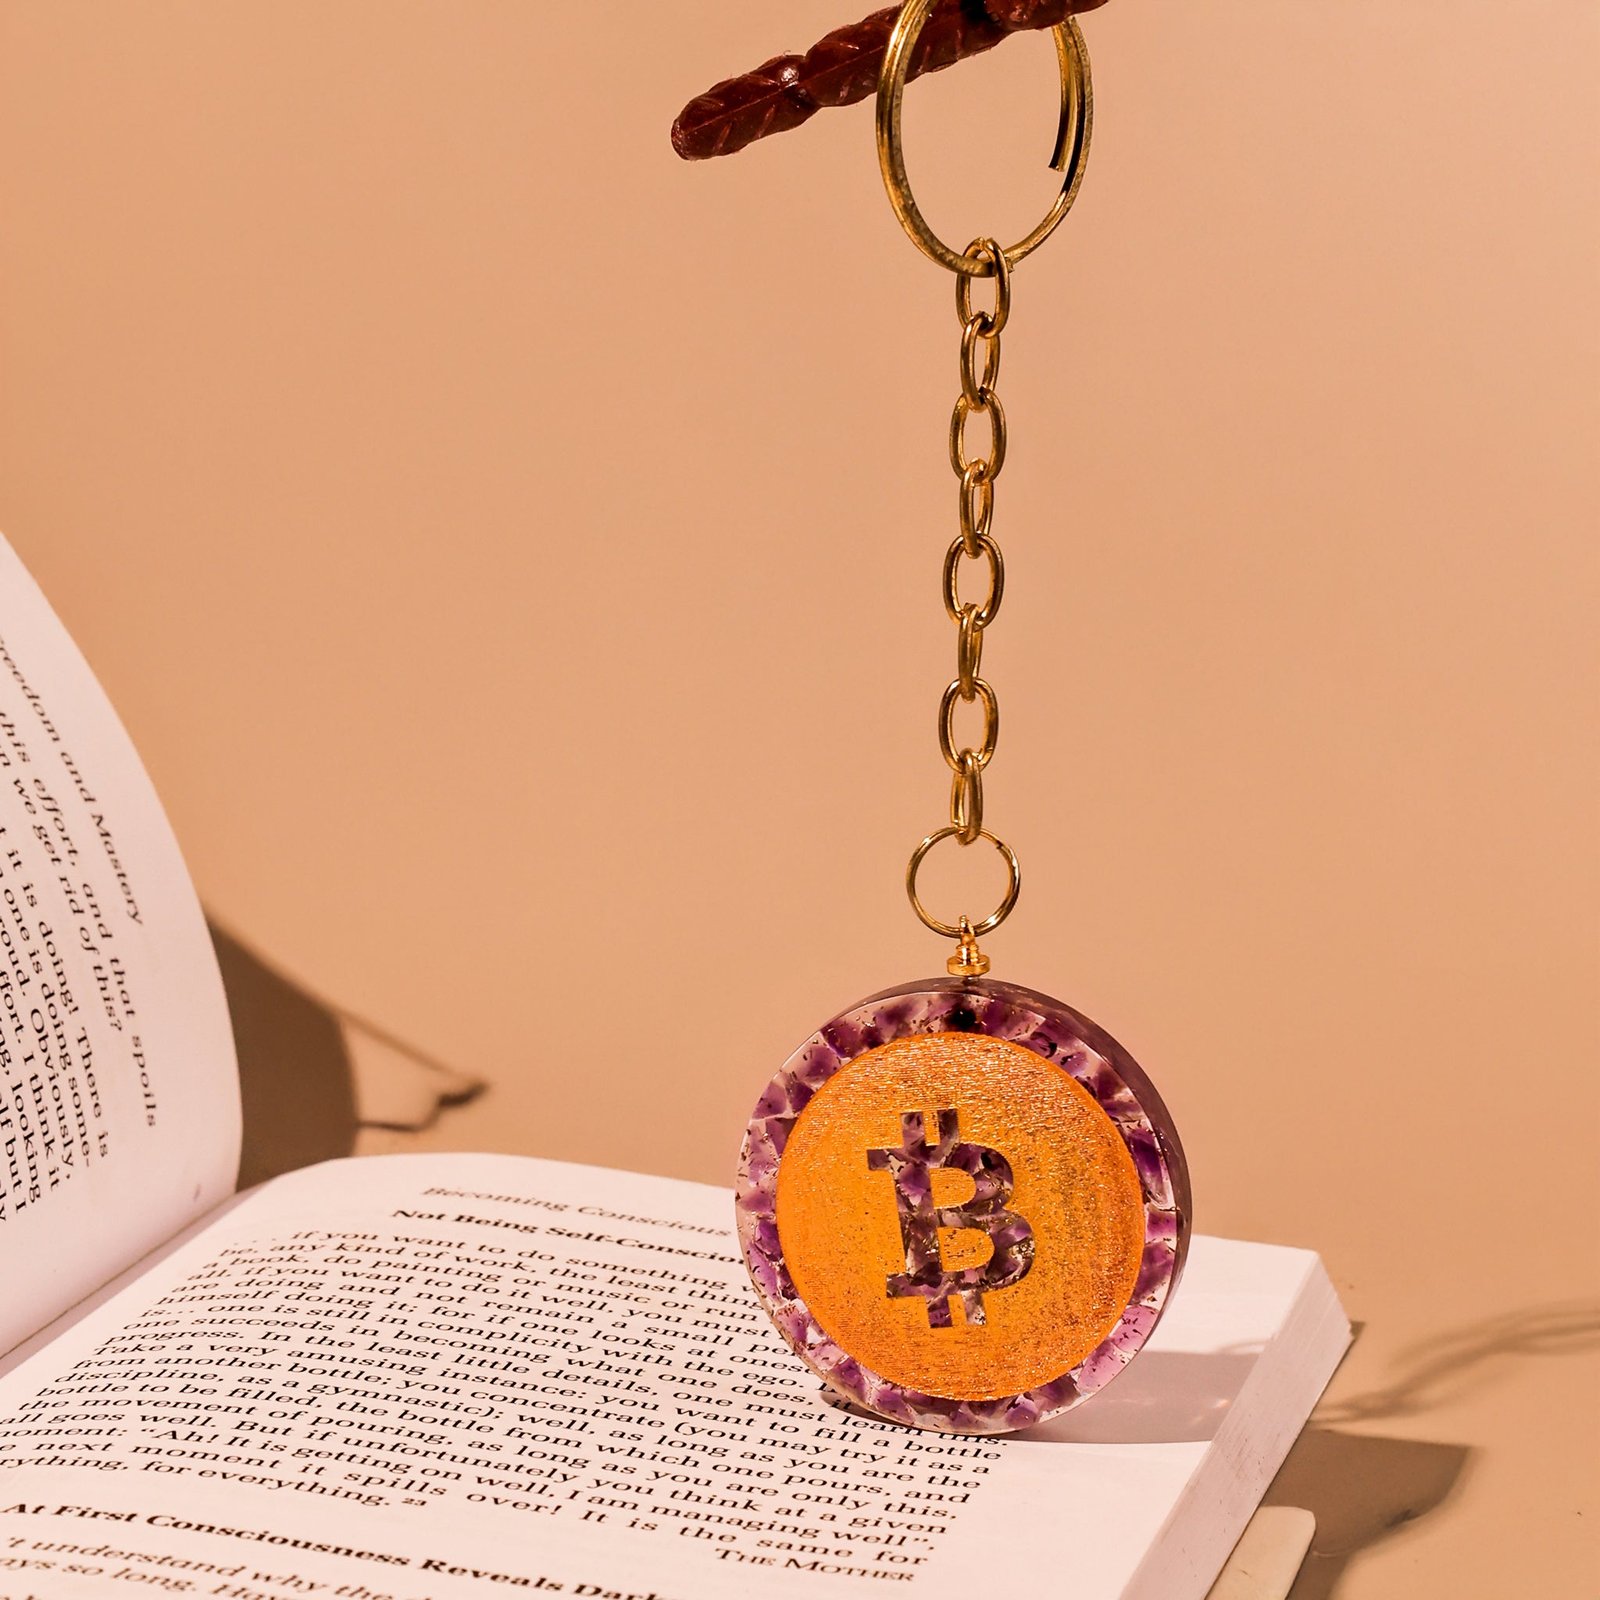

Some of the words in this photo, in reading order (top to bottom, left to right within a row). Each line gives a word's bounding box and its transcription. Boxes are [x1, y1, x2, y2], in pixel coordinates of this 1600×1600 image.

[59, 751, 98, 804] and
[90, 811, 143, 926] Mastery
[12, 778, 37, 815] we
[32, 824, 63, 865] get
[58, 876, 86, 915] rid
[79, 926, 101, 955] of
[92, 964, 123, 1032] this?
[33, 778, 79, 867] effort,
[82, 882, 114, 939] and
[109, 957, 136, 1017] that
[131, 1035, 157, 1127] spoils
[3, 888, 31, 942] one
[27, 948, 43, 975] is
[40, 982, 73, 1072] doing
[67, 1076, 90, 1167] some-
[6, 849, 23, 872] it
[21, 882, 38, 908] is
[38, 920, 80, 1016] doing!
[76, 1026, 102, 1119] There
[97, 1131, 109, 1158] is
[9, 1079, 42, 1204] looking
[22, 1051, 36, 1066] I
[29, 1072, 56, 1160] think
[48, 1166, 60, 1192] it
[30, 1007, 75, 1180] Obviously,
[4, 1133, 23, 1193] but
[15, 1197, 27, 1214] I
[391, 1209, 446, 1221] Not
[452, 1214, 539, 1234] Being
[422, 1187, 570, 1212] Becoming
[577, 1206, 732, 1237] Conscious
[156, 1290, 280, 1305] himself
[283, 1291, 375, 1310] doing
[385, 1300, 418, 1313] it;
[429, 1305, 476, 1320] for
[484, 1314, 516, 1326] if
[520, 1321, 579, 1336] one
[589, 1329, 676, 1352] looks
[686, 1348, 718, 1359] at
[243, 1266, 272, 1276] if
[268, 1268, 329, 1277] you
[341, 1270, 416, 1284] want
[423, 1278, 453, 1288] to
[460, 1282, 501, 1295] do
[507, 1288, 532, 1300] it
[541, 1295, 614, 1314] well,
[621, 1308, 683, 1324] you
[690, 1319, 771, 1338] must
[94, 1343, 167, 1356] Take
[209, 1344, 279, 1357] very
[286, 1350, 429, 1376] amusing
[436, 1367, 587, 1399] instance:
[594, 1394, 660, 1412] you
[674, 1406, 757, 1428] want
[768, 1421, 800, 1434] to
[811, 1427, 862, 1444] fill
[872, 1439, 890, 1448] a
[903, 1439, 1002, 1460] bottle
[102, 1331, 245, 1346] progress.
[257, 1330, 292, 1342] In
[304, 1335, 356, 1349] the
[364, 1341, 443, 1361] least
[450, 1353, 531, 1374] little
[541, 1368, 658, 1397] details,
[672, 1391, 734, 1407] one
[742, 1402, 829, 1423] must
[838, 1415, 923, 1437] learn
[123, 1319, 181, 1330] one
[190, 1318, 336, 1332] succeeds
[345, 1324, 380, 1337] in
[393, 1329, 553, 1364] becoming
[565, 1357, 646, 1378] what
[657, 1373, 718, 1389] one
[730, 1383, 814, 1406] does,
[0, 1412, 44, 1425] all
[47, 1413, 126, 1424] goes
[139, 1414, 217, 1428] well.
[230, 1420, 295, 1436] But
[303, 1429, 338, 1442] if
[342, 1437, 580, 1484] unfortunately
[586, 1478, 655, 1496] you
[669, 1489, 760, 1512] think
[774, 1507, 807, 1518] at
[818, 1513, 837, 1522] a
[847, 1517, 947, 1534] given
[35, 1382, 130, 1397] bottle
[138, 1383, 170, 1393] to
[178, 1383, 218, 1396] be
[225, 1387, 323, 1409] filled,
[335, 1401, 389, 1417] the
[397, 1409, 495, 1434] bottle
[502, 1426, 583, 1449] from
[596, 1443, 700, 1469] which
[711, 1464, 775, 1479] one
[780, 1474, 891, 1497] pours,
[903, 1490, 971, 1504] and
[140, 1460, 192, 1475] for
[197, 1469, 390, 1507] everything.
[224, 1435, 252, 1448] It
[257, 1440, 288, 1452] is
[290, 1447, 414, 1475] getting
[420, 1468, 462, 1481] on
[475, 1475, 555, 1498] well,
[566, 1489, 584, 1501] I
[586, 1496, 639, 1511] am
[650, 1505, 821, 1539] managing
[0, 1503, 46, 1515] At
[52, 1505, 138, 1523] First
[145, 1515, 411, 1566] Consciousness
[419, 1558, 564, 1592] Reveals
[32, 1442, 114, 1452] next
[130, 1445, 282, 1469] moment
[298, 1463, 327, 1476] it
[343, 1473, 447, 1496] spills
[466, 1493, 563, 1516] over!
[581, 1510, 609, 1523] It
[627, 1517, 659, 1531] is
[679, 1526, 737, 1543] the
[756, 1539, 853, 1557] same
[874, 1550, 928, 1565] for
